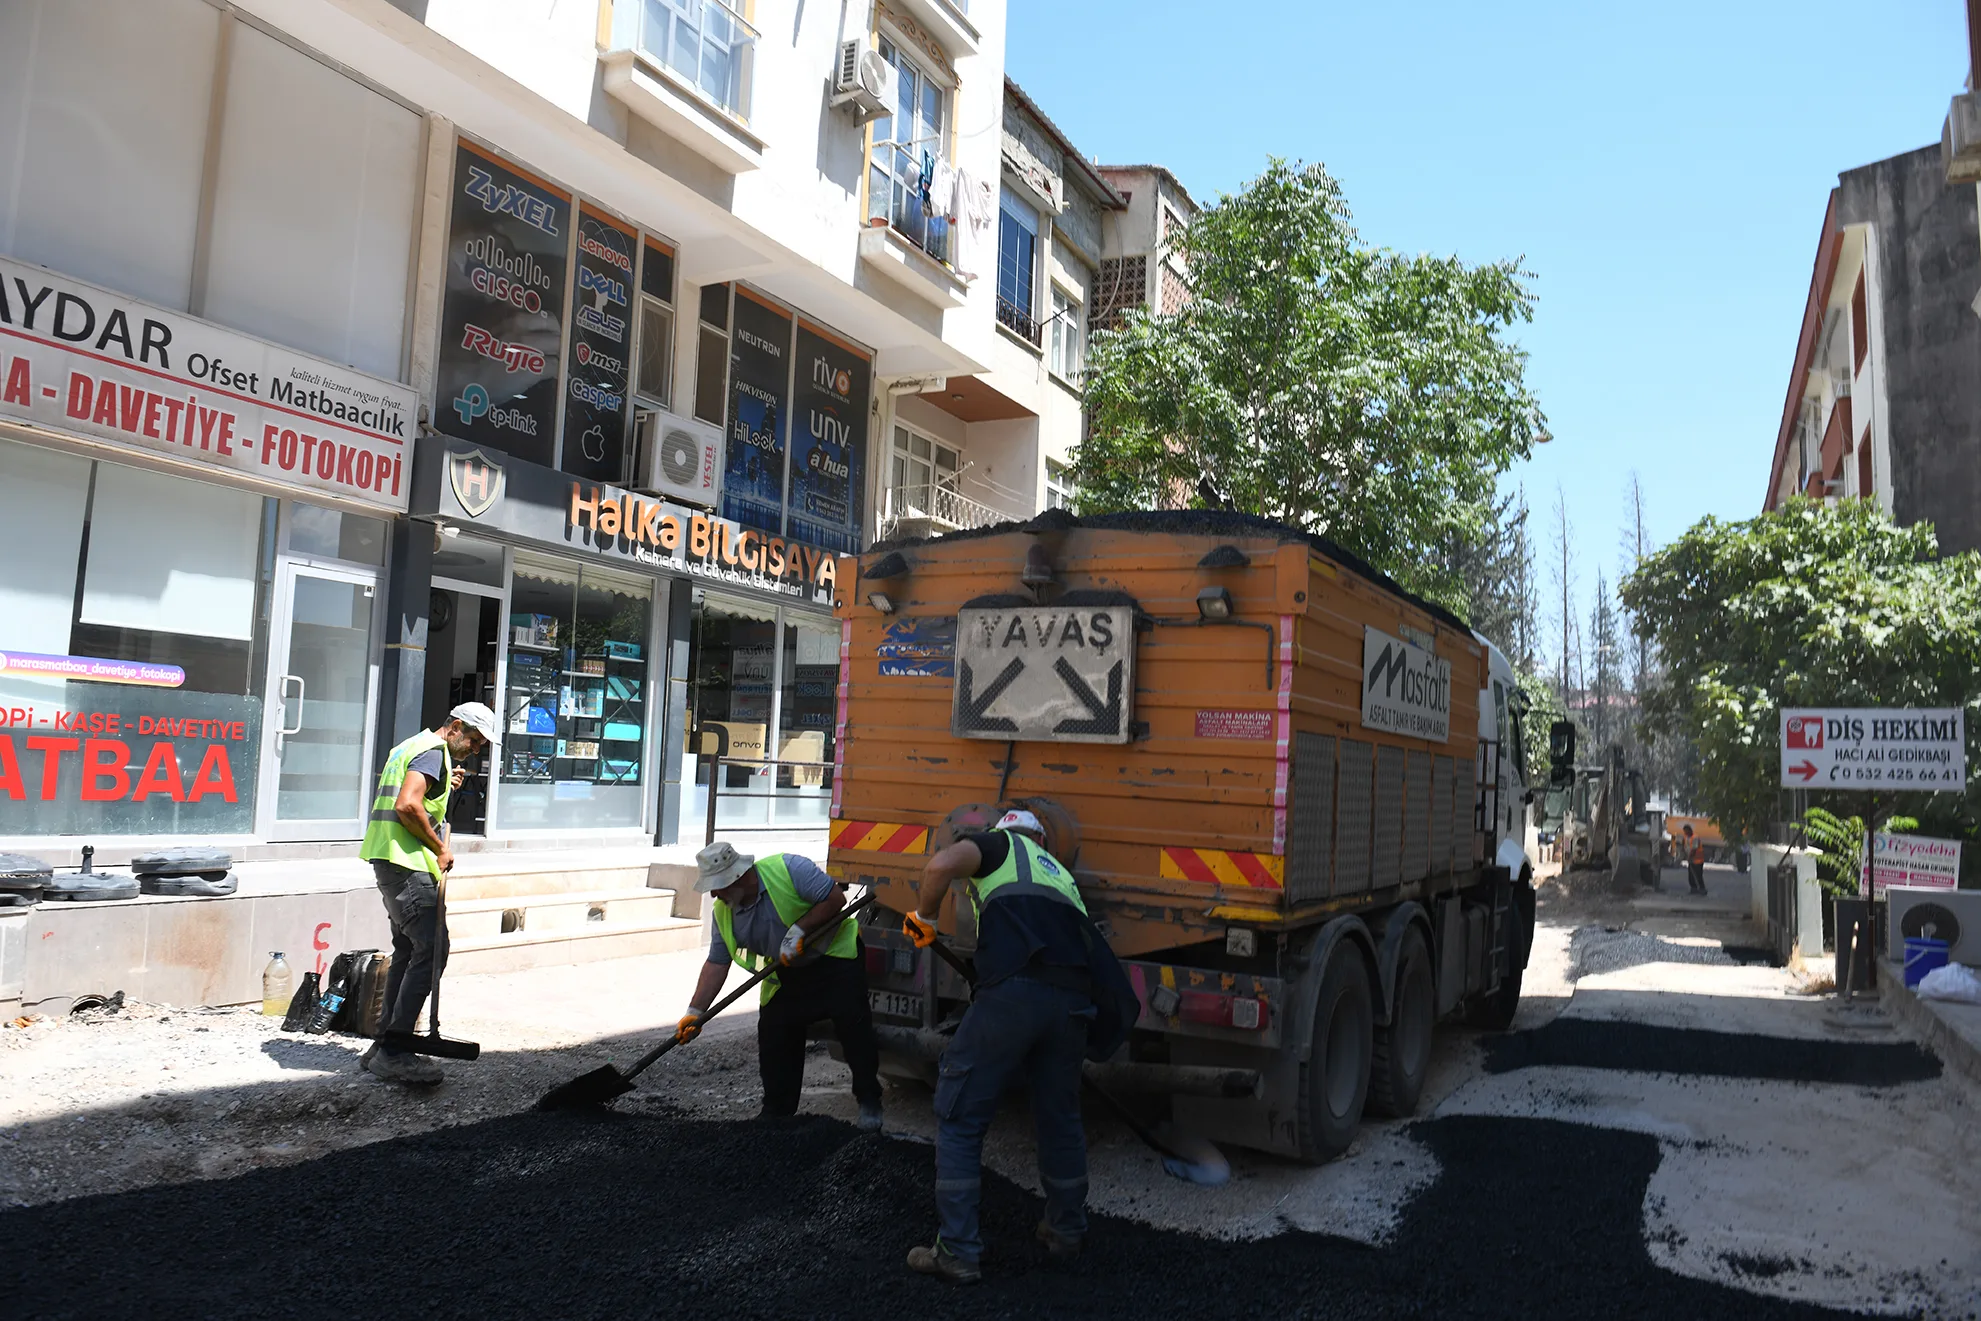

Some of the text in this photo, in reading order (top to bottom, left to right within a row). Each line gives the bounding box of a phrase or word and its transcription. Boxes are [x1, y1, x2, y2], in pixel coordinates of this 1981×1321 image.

[464, 165, 559, 237] ZyXEL
[579, 230, 632, 272] Lenovo
[579, 265, 627, 308] DELL
[577, 304, 625, 335] ASUS
[738, 328, 781, 358] NEUTRON
[589, 350, 621, 374] msi
[187, 352, 260, 395] Ofset
[270, 377, 404, 436] Matbaacılık
[290, 367, 321, 385] kaliteli
[322, 377, 352, 395] hizmet
[353, 389, 379, 404] uygun
[570, 377, 622, 412] Casper
[735, 380, 778, 406] HIKVISION
[66, 371, 236, 456] DAVETİYE
[261, 423, 402, 496] FOTOKOPİ
[488, 404, 538, 436] tp-link
[463, 459, 489, 501] H
[703, 444, 713, 489] VESTEL
[978, 613, 1114, 655] YAVAŞ
[10, 657, 181, 681] marasmatbaa_davetiye_fotokopi
[1368, 642, 1448, 715] Masfalt
[54, 711, 120, 738] KAŞE
[1196, 711, 1233, 720] YOLSAN
[1827, 714, 1958, 746] DİŞ HEKİMİ
[1835, 748, 1864, 762] HACI
[1888, 746, 1951, 767] GEDİKBAŞI
[1842, 768, 1958, 782] 0 532 425 66 41
[886, 993, 917, 1016] 1131
